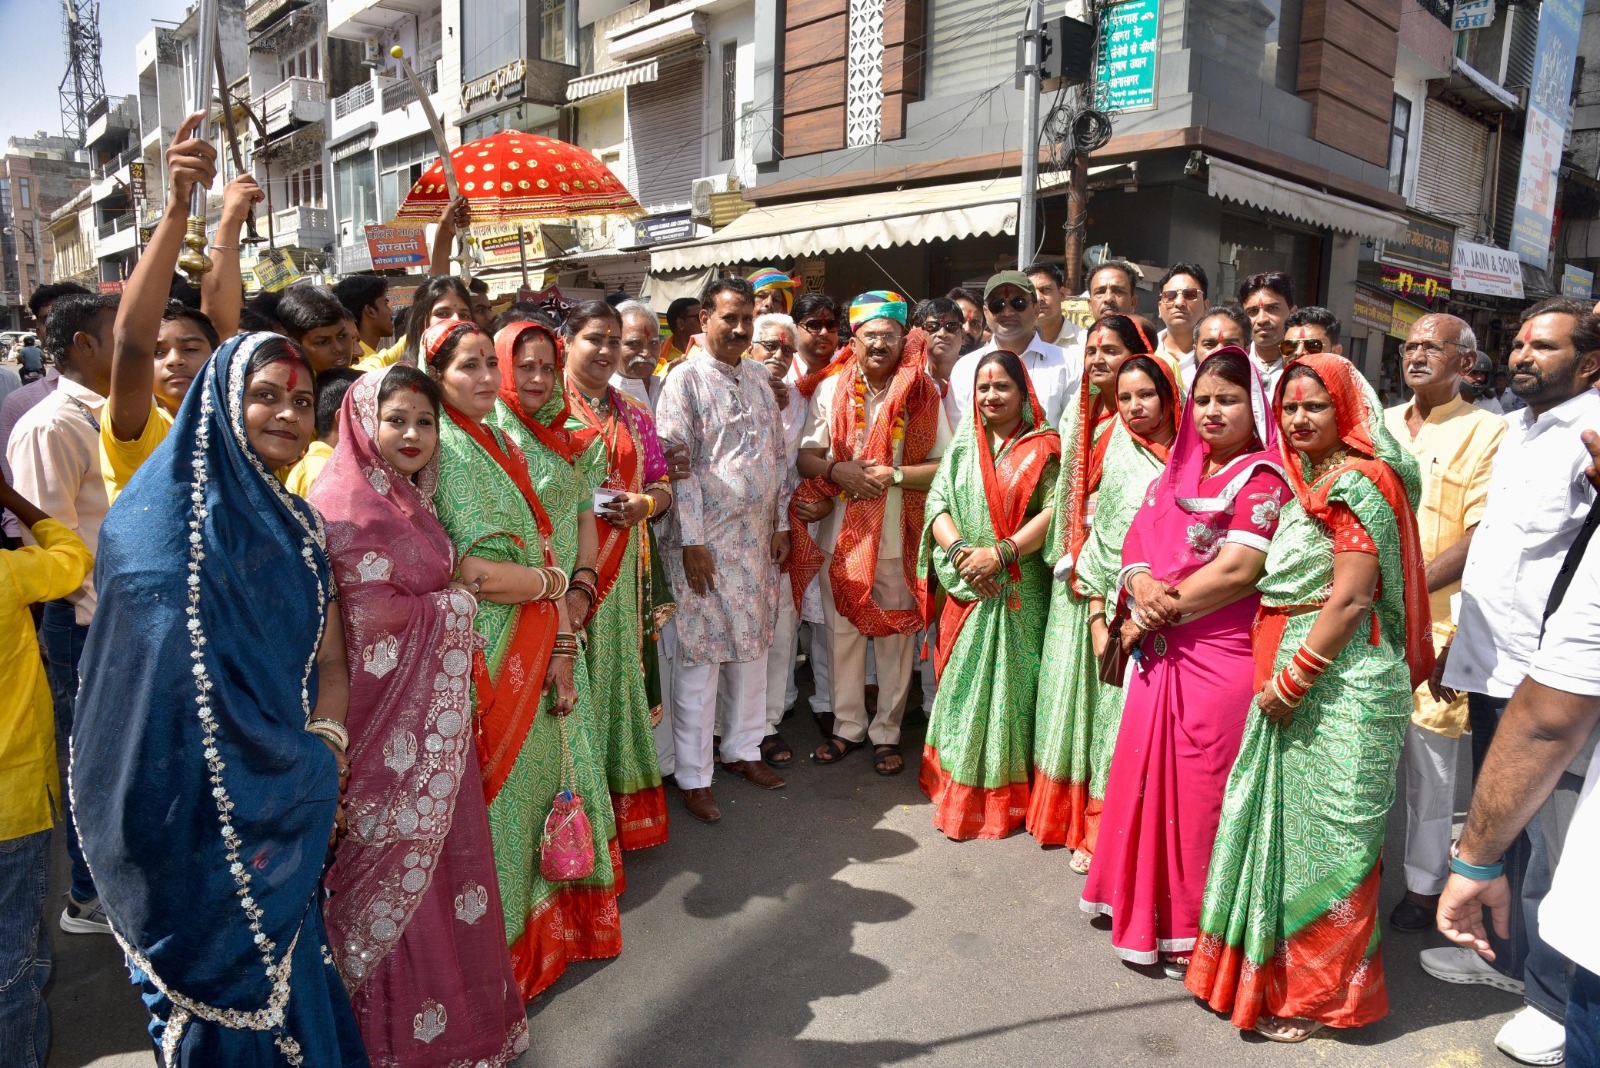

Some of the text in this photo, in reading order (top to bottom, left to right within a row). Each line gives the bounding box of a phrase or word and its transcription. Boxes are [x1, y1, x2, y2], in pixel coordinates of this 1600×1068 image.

[1133, 25, 1144, 38] गेट
[460, 59, 527, 110] Kanwar Sahab
[375, 239, 419, 253] शेरवानी
[1471, 250, 1489, 271] JAIN
[1491, 256, 1498, 272] &
[1498, 256, 1520, 275] SONS
